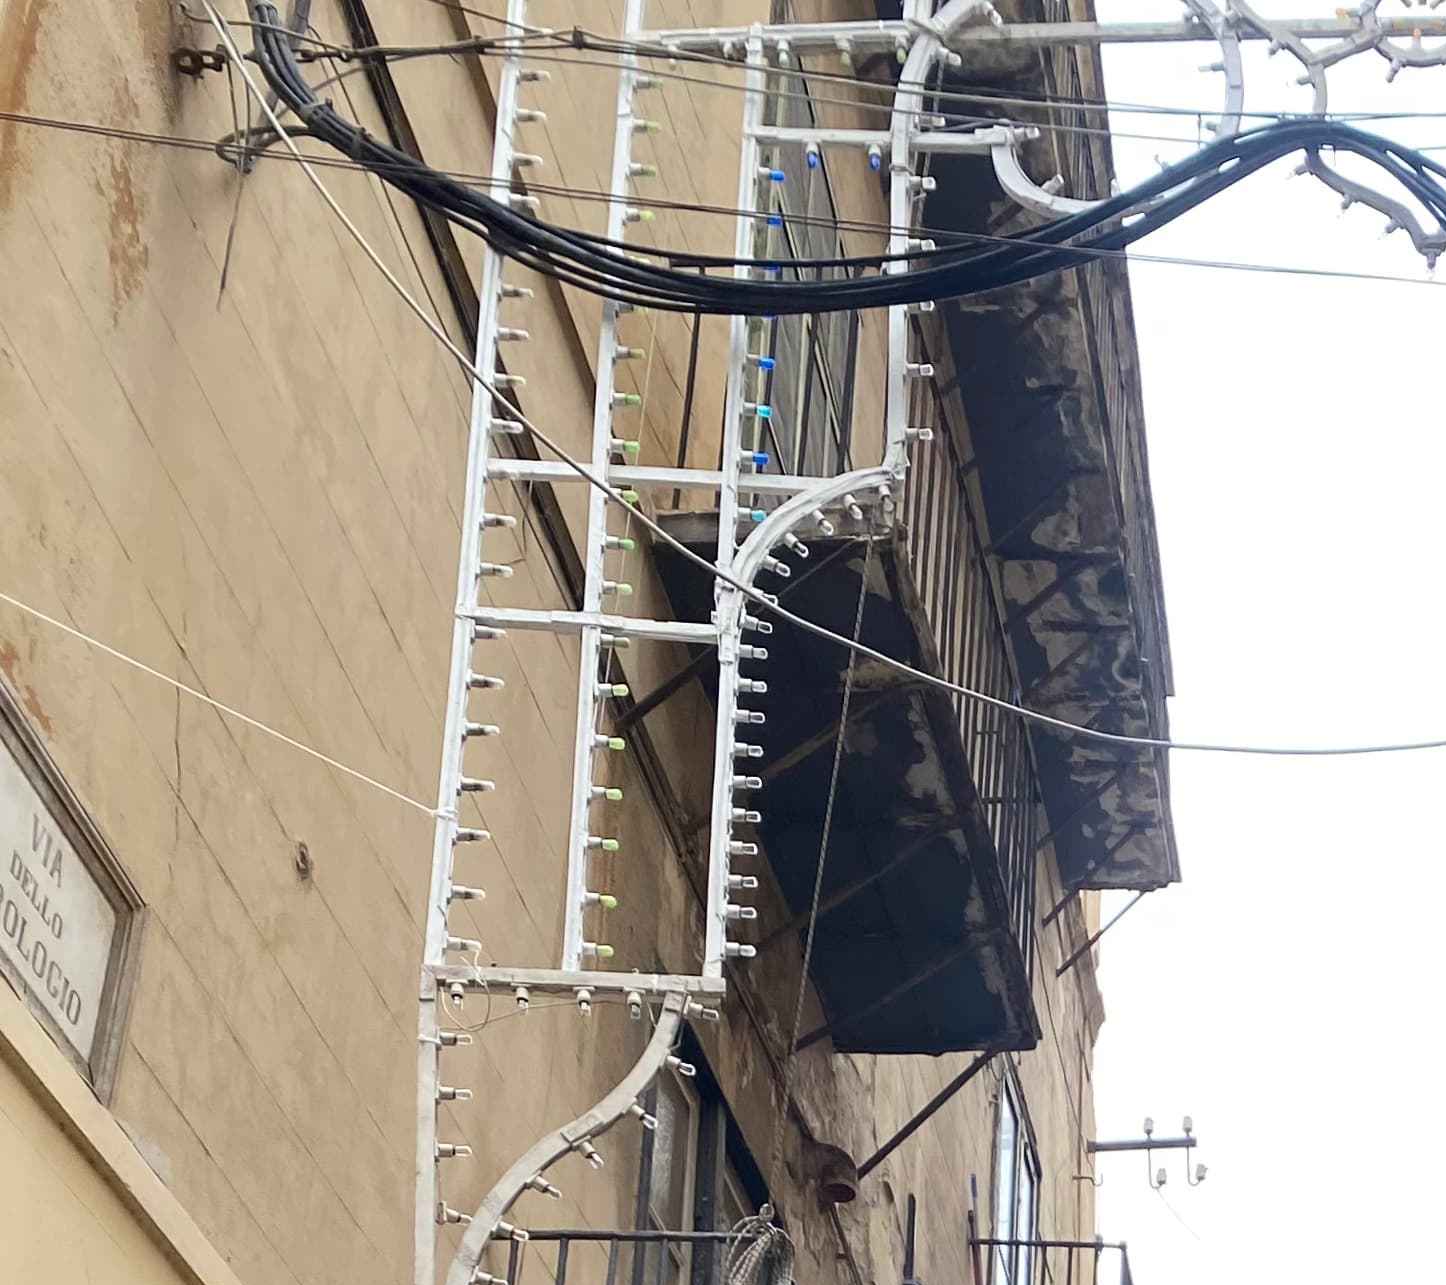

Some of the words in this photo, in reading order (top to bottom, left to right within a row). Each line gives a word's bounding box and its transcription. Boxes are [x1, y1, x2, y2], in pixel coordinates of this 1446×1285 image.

[10, 849, 63, 940] DELLO
[32, 813, 62, 888] VIA
[0, 883, 82, 1026] OLOGIO
